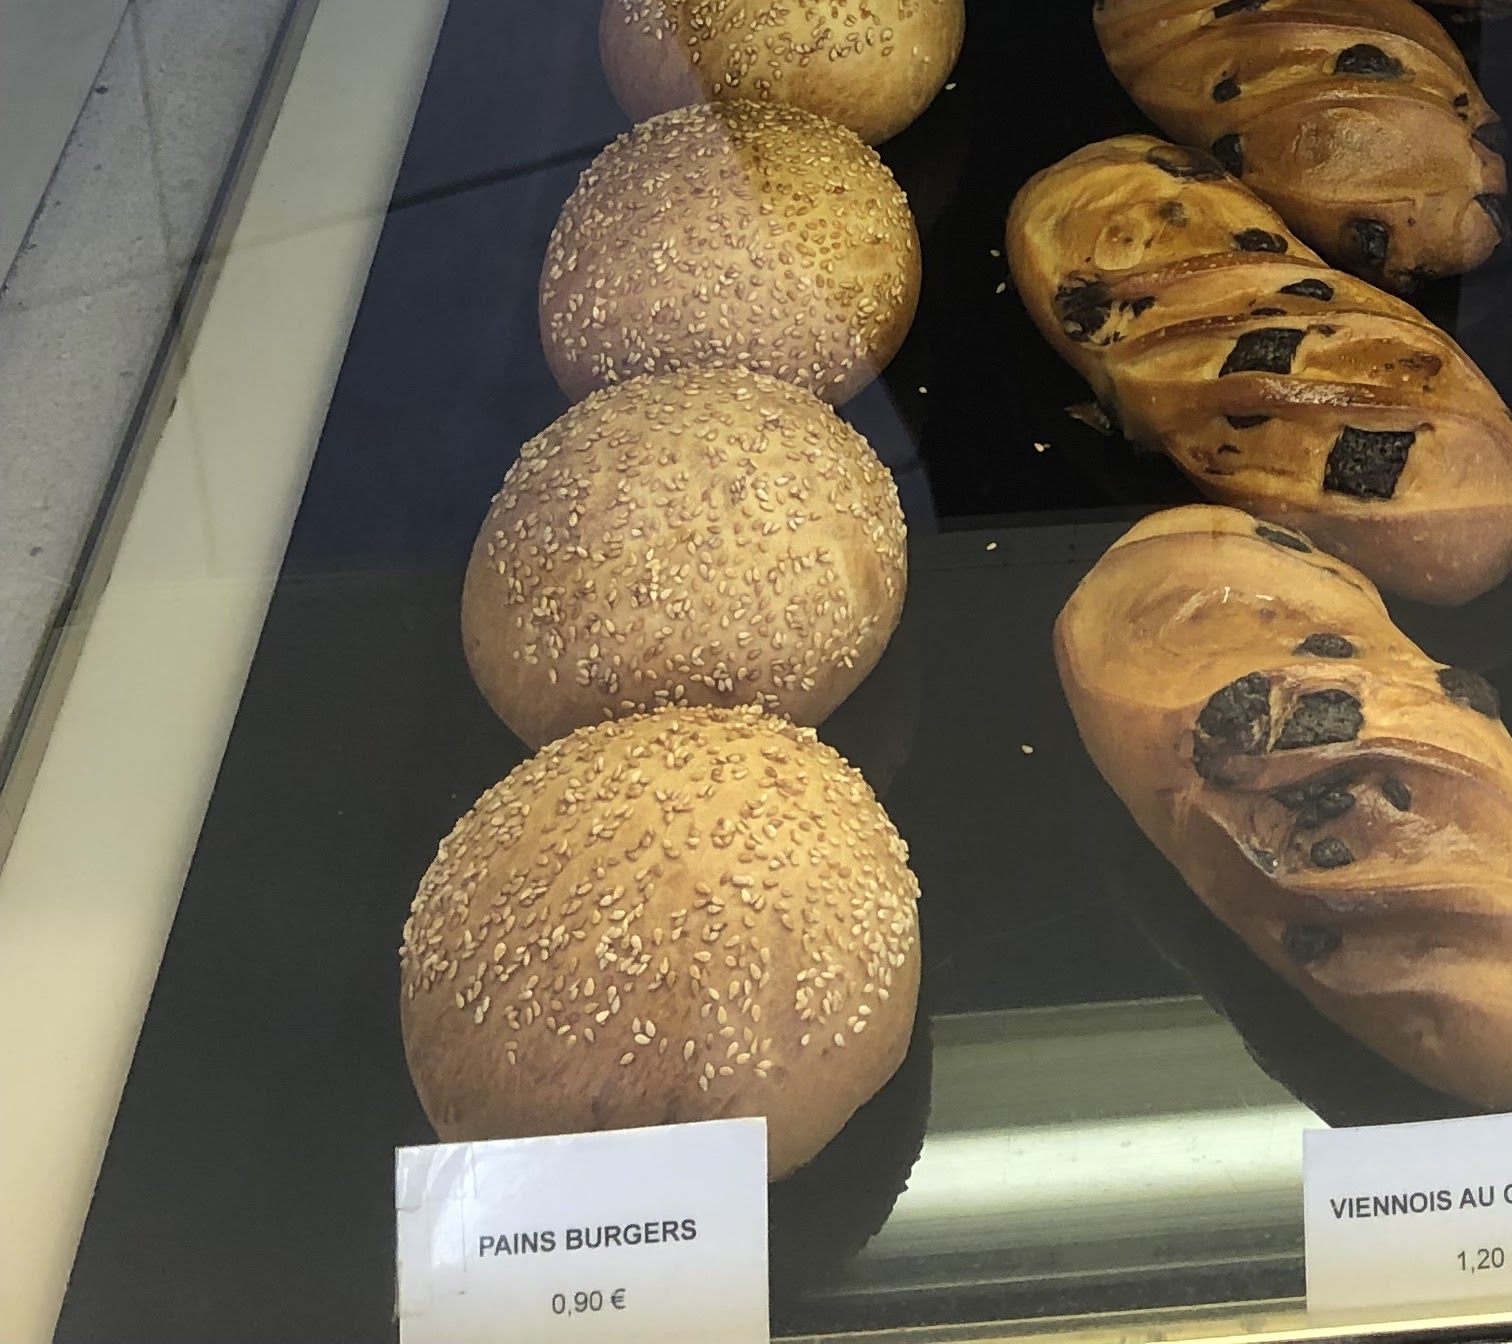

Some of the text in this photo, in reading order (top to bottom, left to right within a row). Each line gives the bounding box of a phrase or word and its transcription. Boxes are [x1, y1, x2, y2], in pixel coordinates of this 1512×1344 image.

[1329, 1189, 1453, 1220] VIENNOIS
[1458, 1185, 1495, 1210] AU
[478, 1218, 698, 1258] PAINS BURGERS
[1456, 1246, 1505, 1274] 1,20
[551, 1287, 627, 1318] 0,90 €
